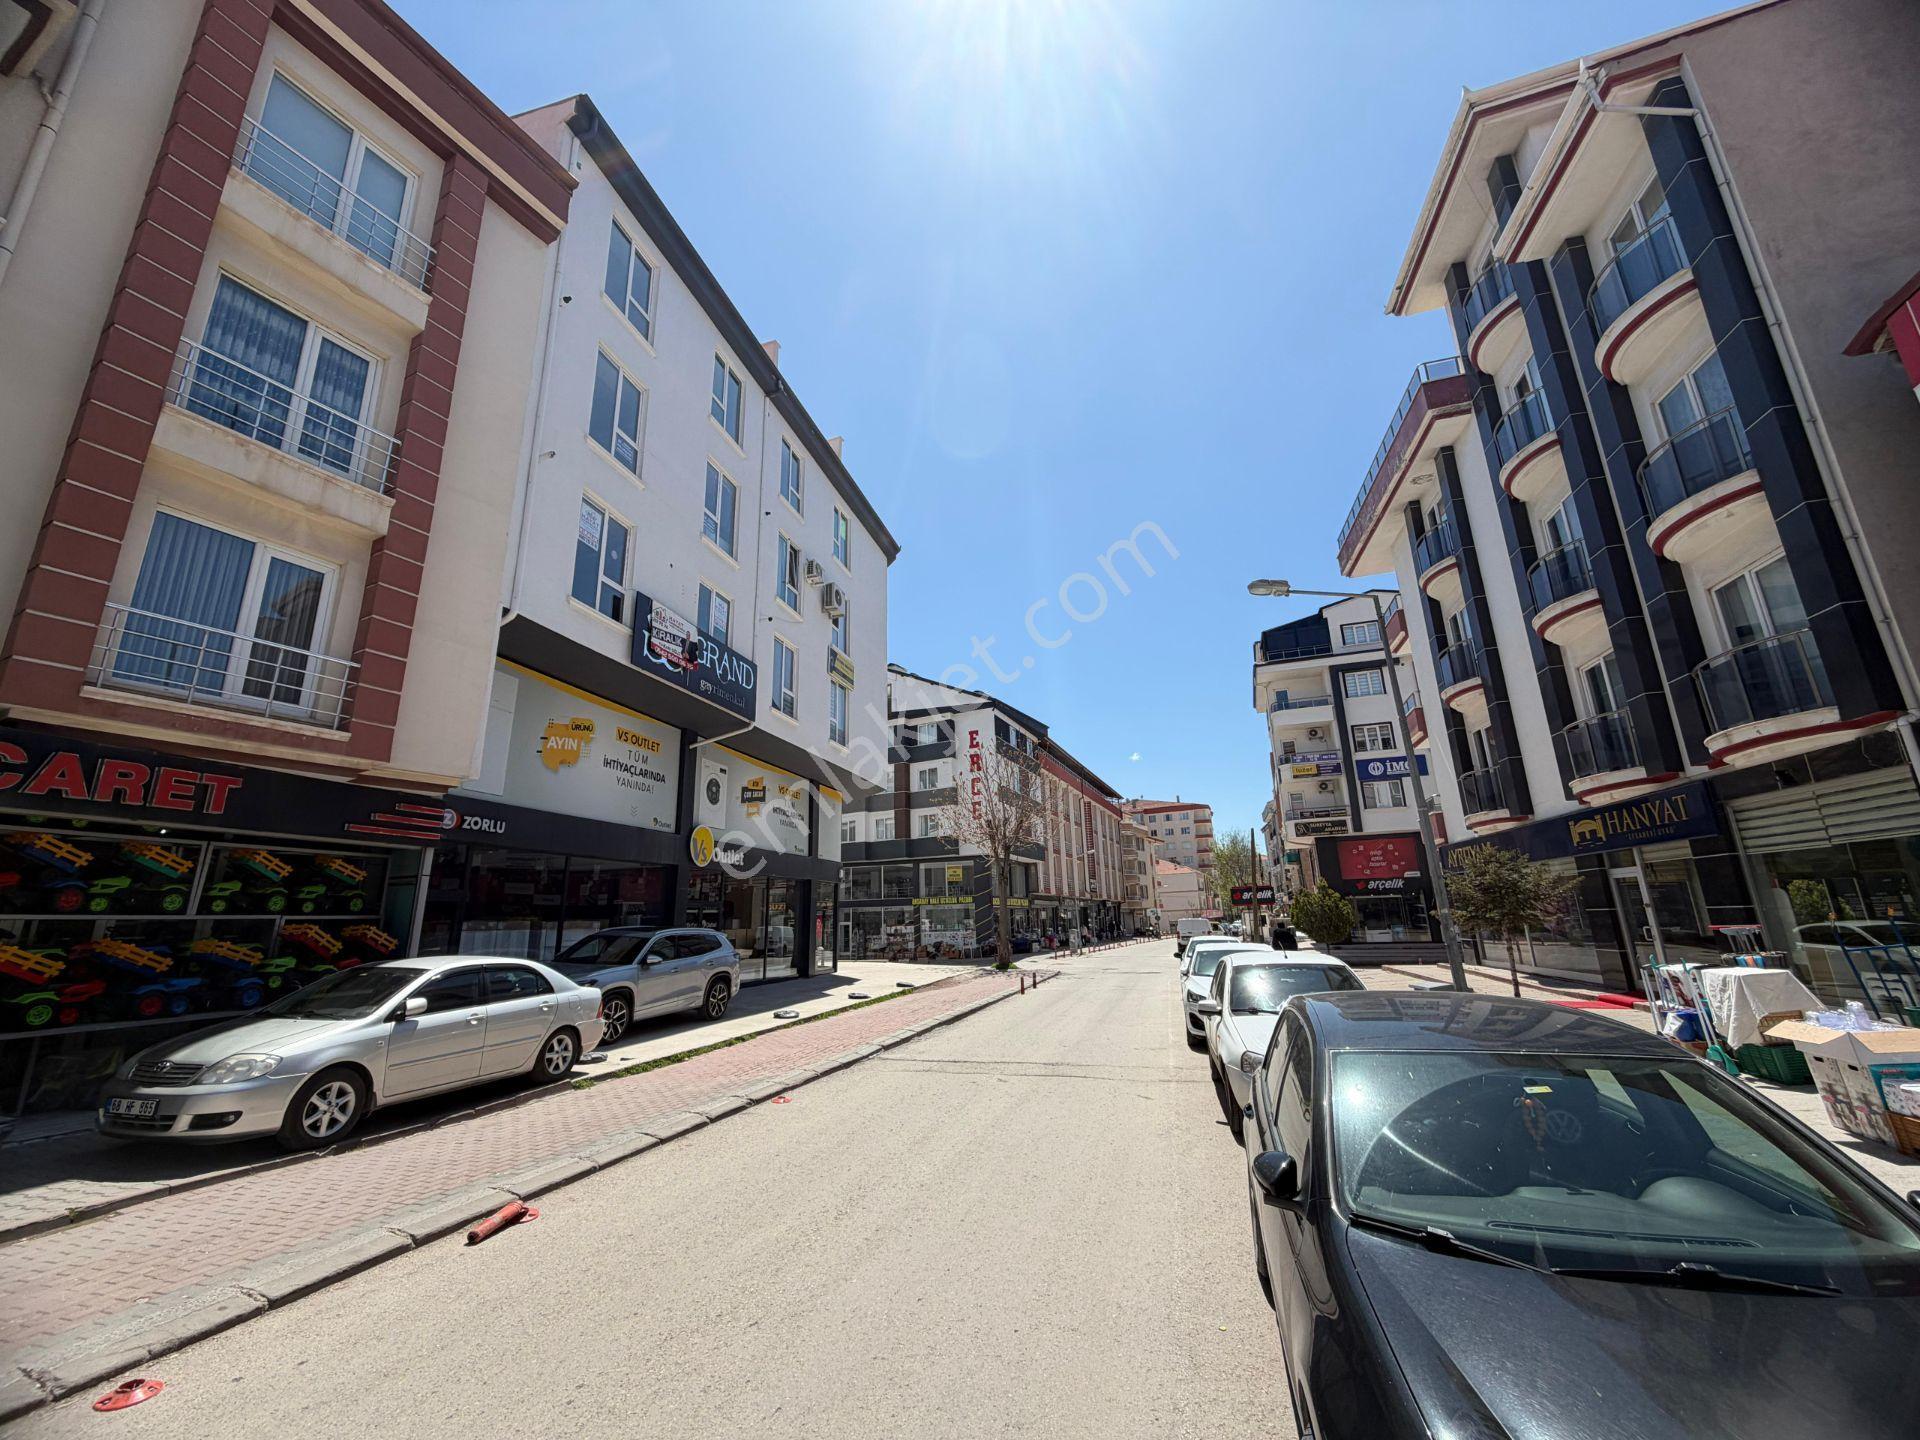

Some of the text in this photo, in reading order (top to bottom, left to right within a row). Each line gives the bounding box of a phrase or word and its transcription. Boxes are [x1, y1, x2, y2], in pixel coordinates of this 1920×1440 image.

[697, 636, 754, 689] GRAND
[700, 679, 745, 708] gayrimenkul
[571, 721, 593, 732] ÜRÜNÜ
[547, 736, 578, 750] AYIN
[617, 729, 660, 753] VS OUTLET
[627, 749, 649, 764] TÜM
[603, 754, 666, 783] İHTİYAÇLARINDA
[1605, 794, 1690, 835] HANYAT
[462, 816, 506, 833] ZORLU
[713, 847, 745, 866] Outlet
[1367, 879, 1405, 890] arçelik
[1242, 890, 1273, 900] arelik
